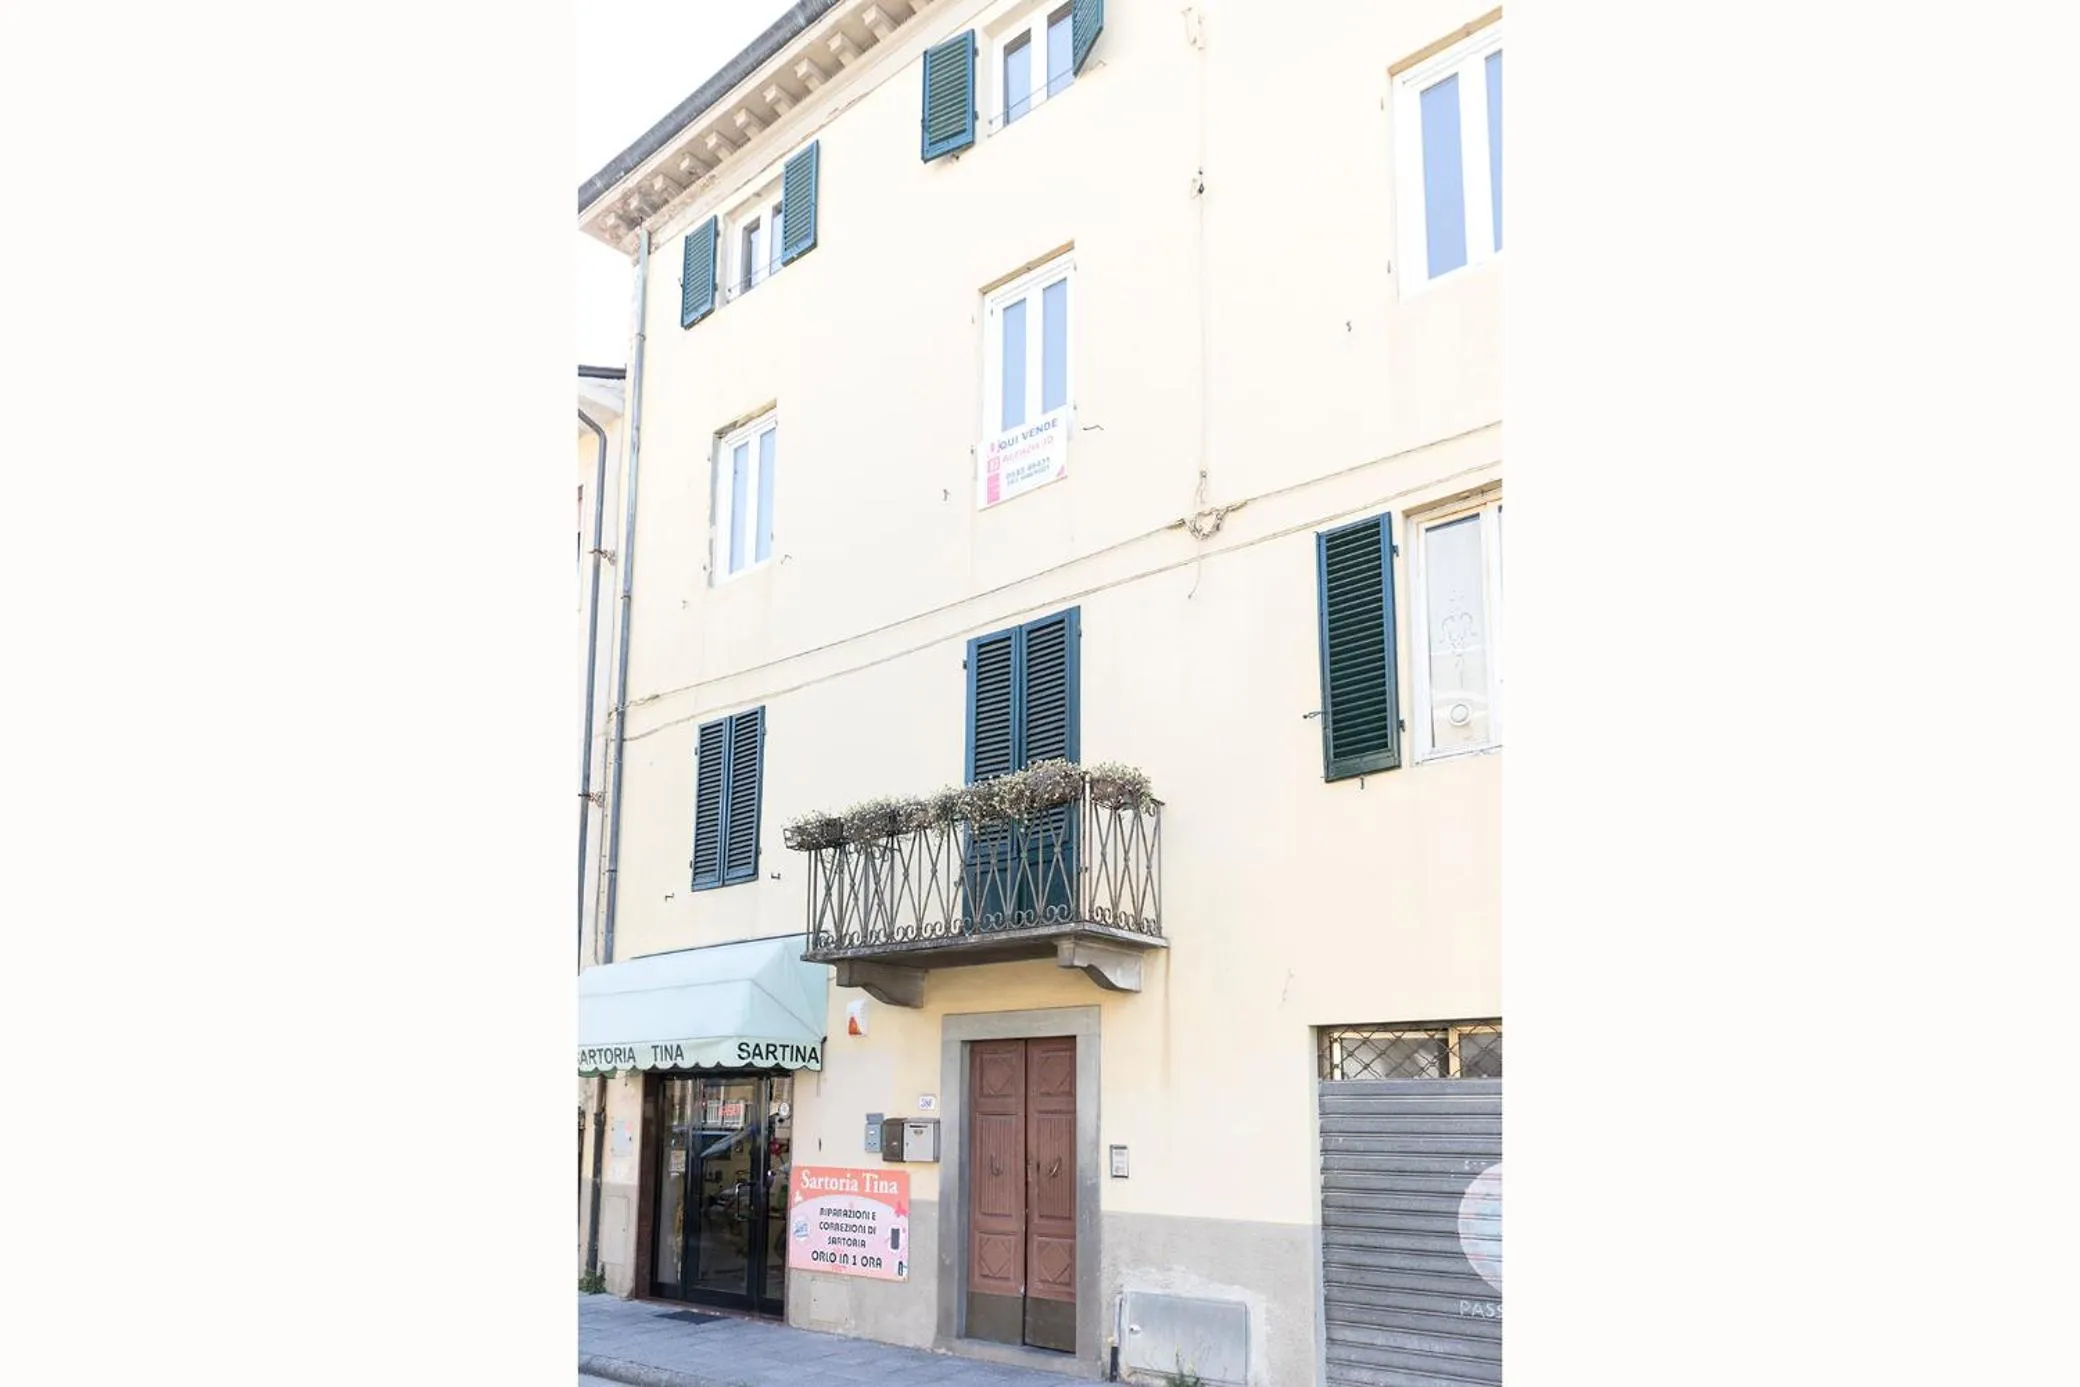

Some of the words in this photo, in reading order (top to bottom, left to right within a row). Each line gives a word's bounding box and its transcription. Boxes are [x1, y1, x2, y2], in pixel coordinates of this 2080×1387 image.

[999, 436, 1019, 450] QUI
[1021, 418, 1058, 440] VENDE
[577, 1047, 636, 1065] ARTORIA
[651, 1044, 685, 1062] TINA
[737, 1042, 820, 1064] SARTINA
[800, 1169, 859, 1192] Sartoria
[862, 1172, 898, 1194] Tina
[819, 1207, 870, 1220] RIPARAZIONI
[819, 1221, 866, 1234] CORREZIONI
[868, 1225, 876, 1235] DI
[827, 1236, 866, 1248] SARTORIA
[811, 1250, 837, 1263] ORLO
[839, 1253, 849, 1265] IN
[852, 1255, 857, 1266] 1
[860, 1256, 883, 1269] ORA
